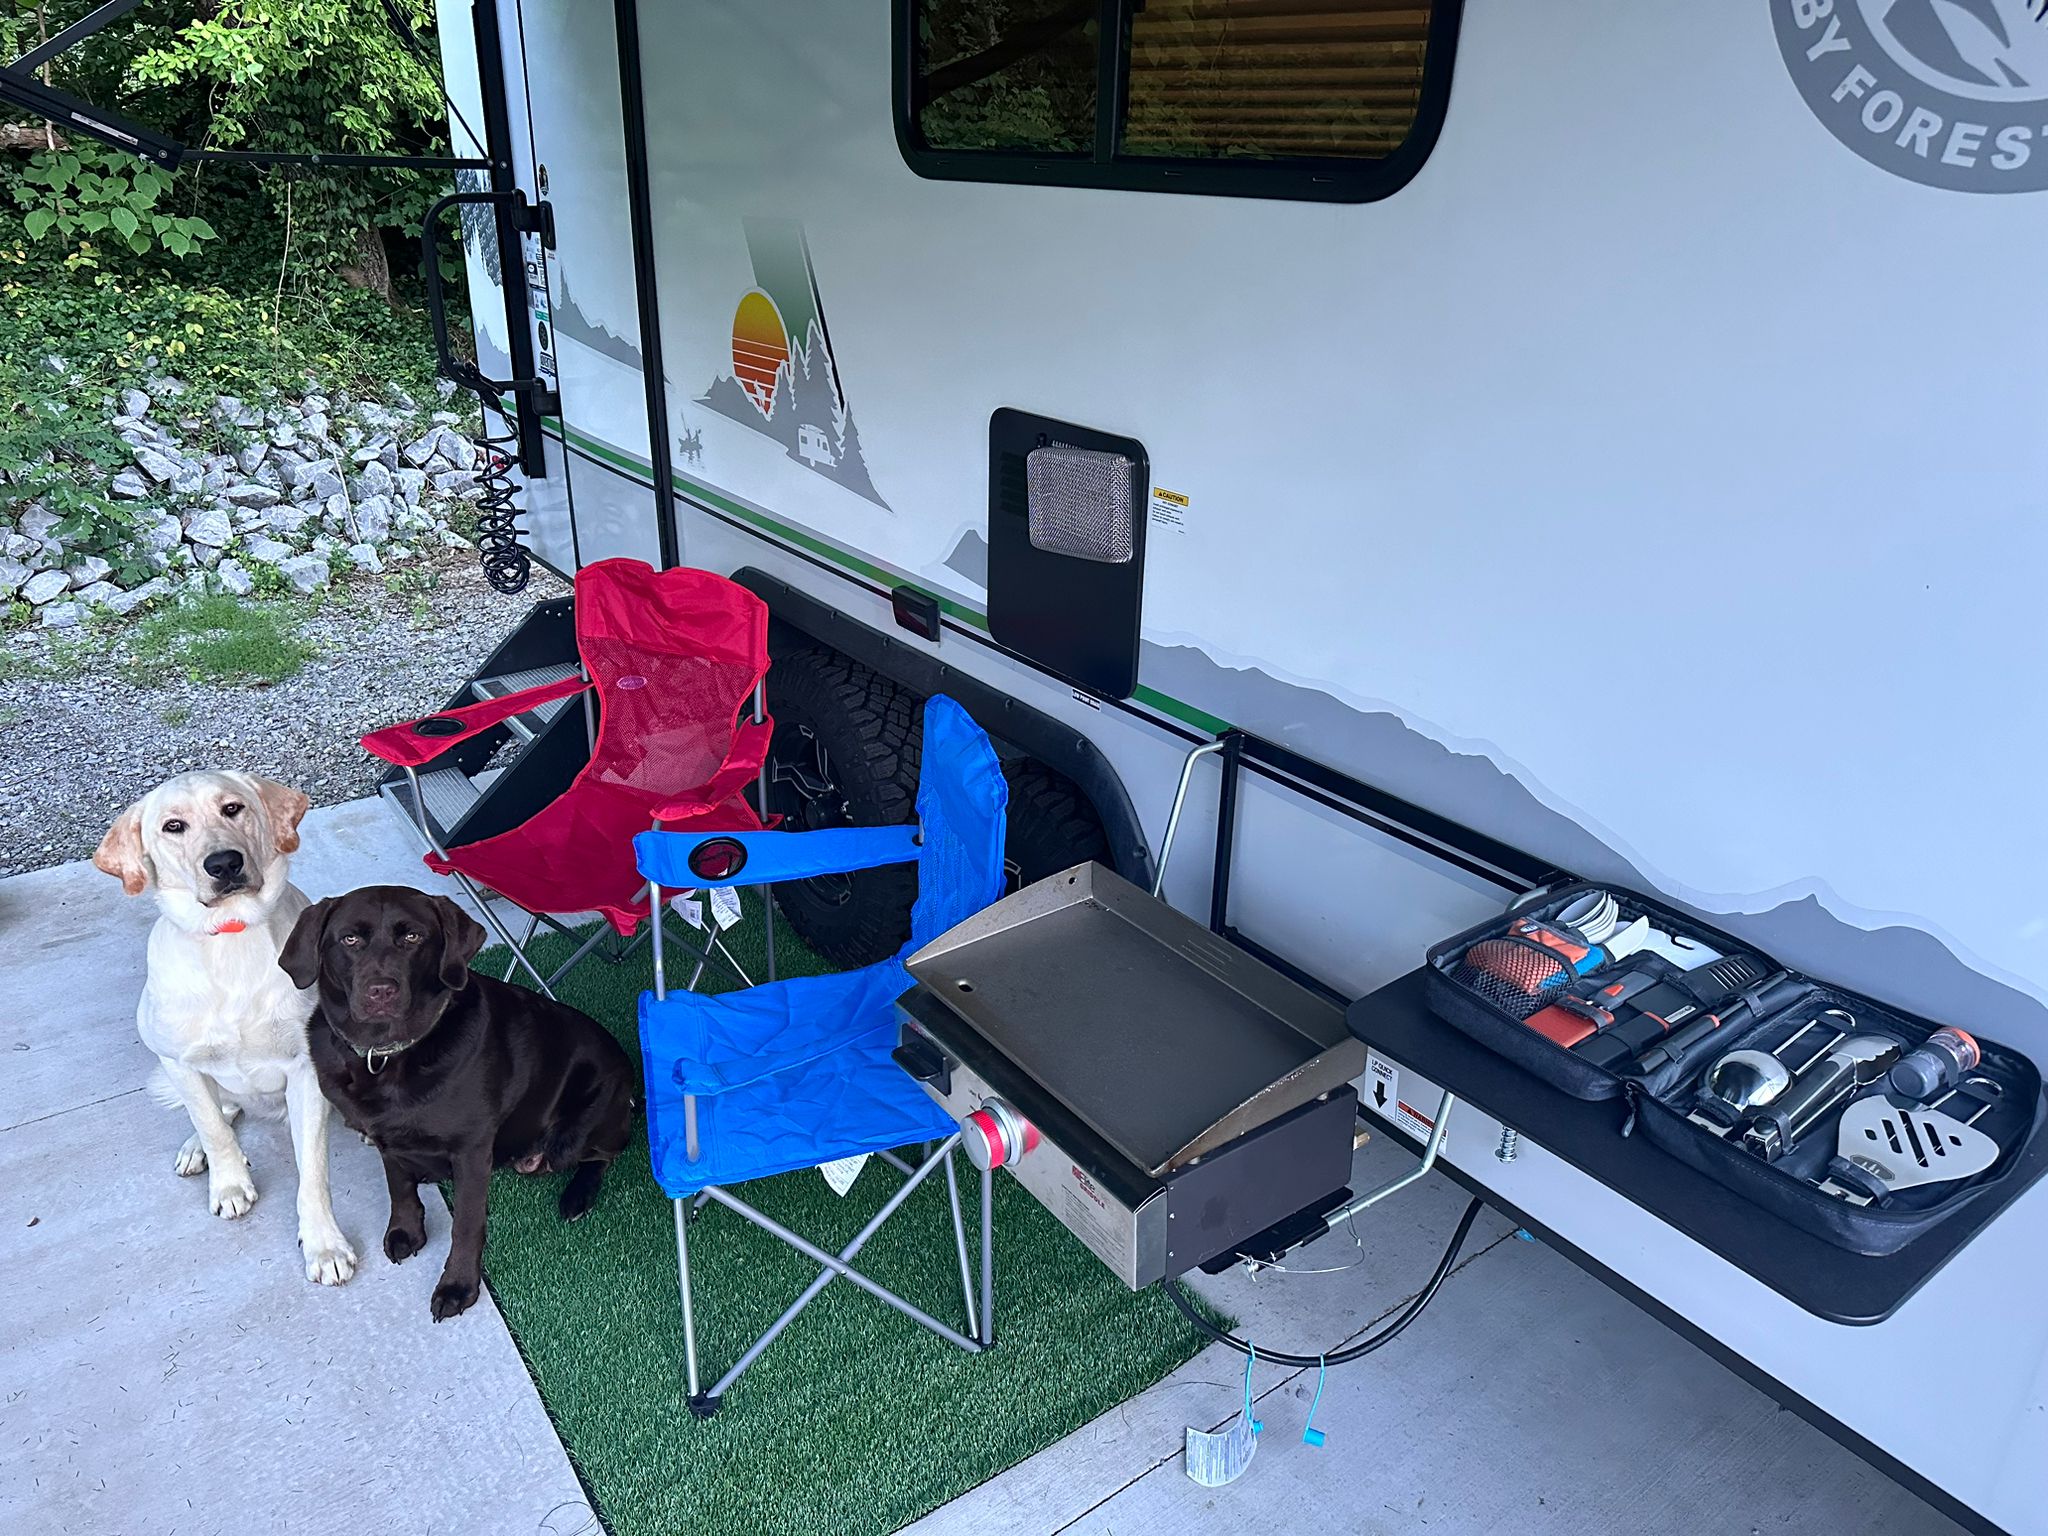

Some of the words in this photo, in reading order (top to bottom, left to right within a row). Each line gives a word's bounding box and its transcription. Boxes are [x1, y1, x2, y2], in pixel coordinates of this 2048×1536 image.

[1791, 0, 1852, 62] BY
[1830, 63, 2048, 170] FORES
[1162, 492, 1184, 503] CAUTION
[1371, 1065, 1393, 1081] CONNECT
[1378, 1061, 1393, 1075] QUICK
